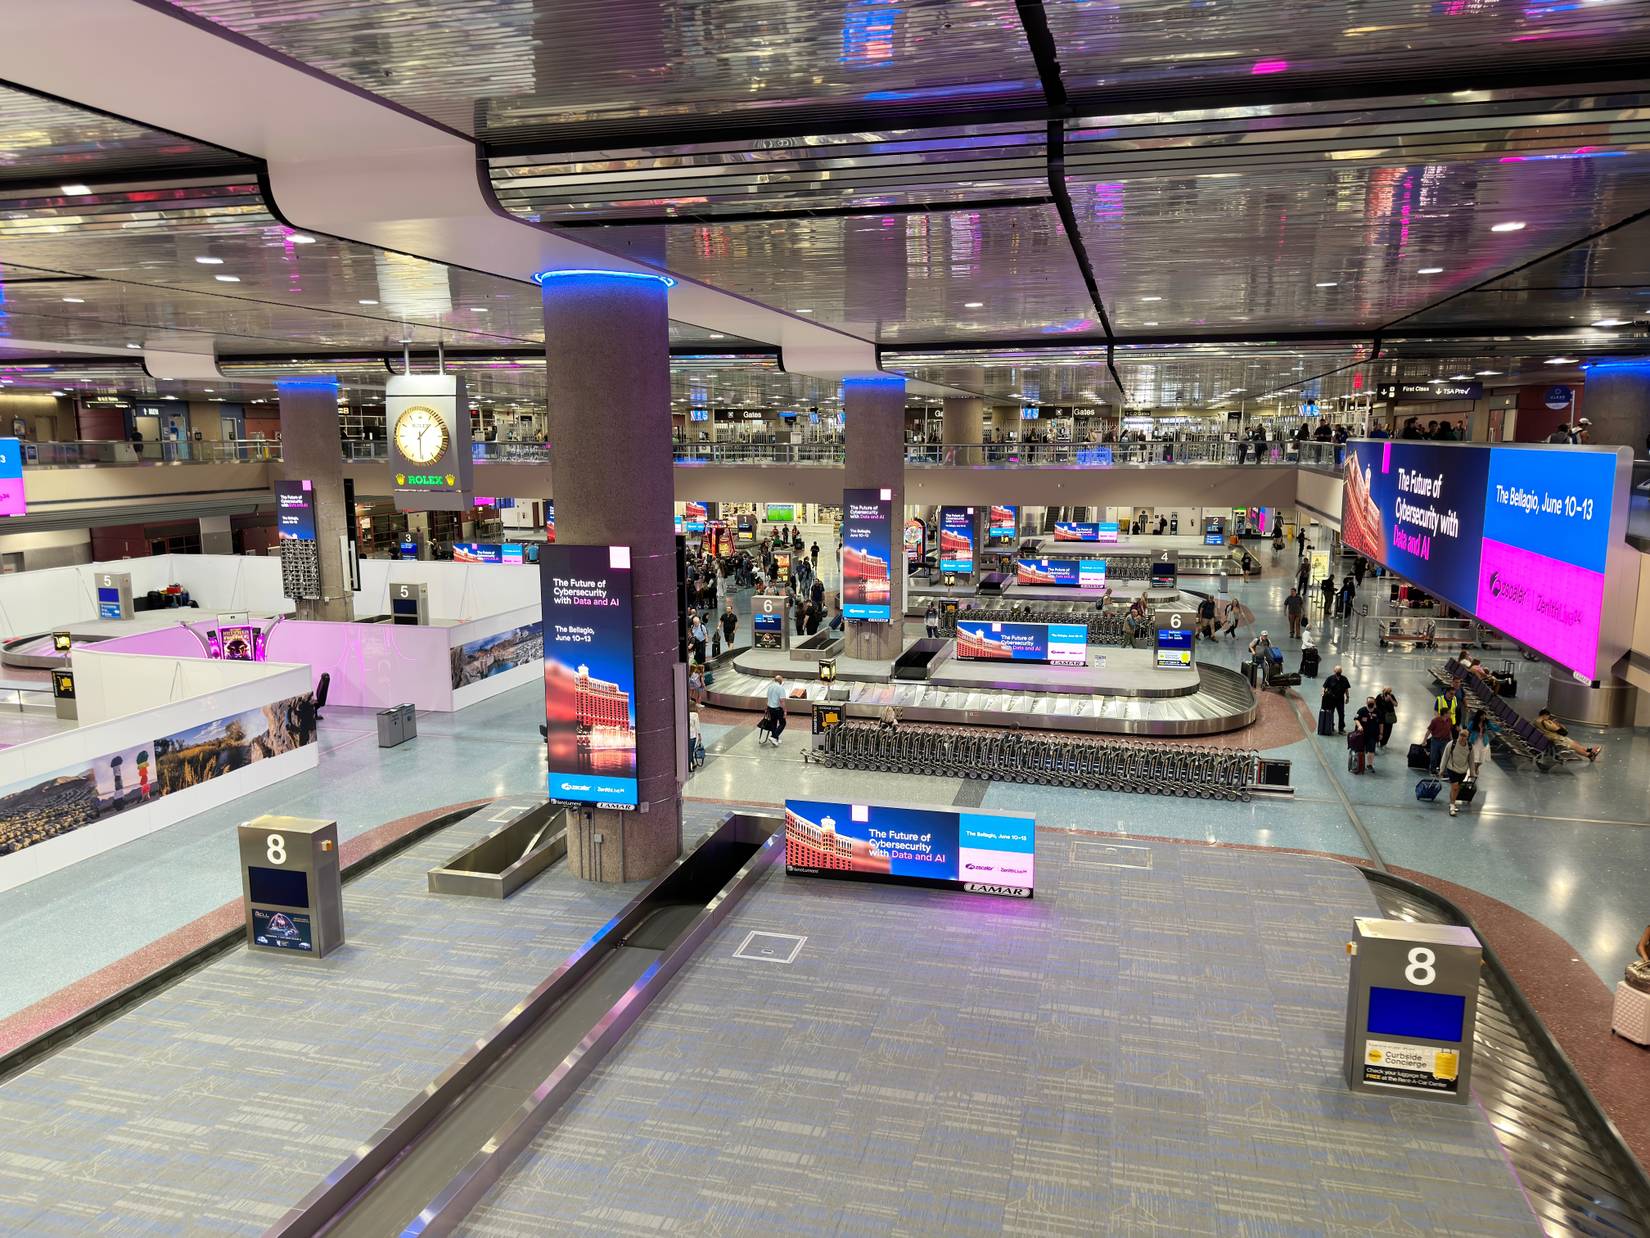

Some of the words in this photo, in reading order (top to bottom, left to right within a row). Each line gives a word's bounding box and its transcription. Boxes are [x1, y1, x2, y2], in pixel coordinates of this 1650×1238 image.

[408, 475, 443, 485] ROLEX
[1398, 468, 1410, 492] The
[1410, 470, 1432, 496] Future
[1432, 474, 1442, 498] of
[1496, 485, 1509, 504] The
[1510, 487, 1540, 514] Bellagio,
[1542, 492, 1562, 515] June
[1396, 496, 1440, 537] Cybersecurity
[1440, 509, 1458, 538] with
[406, 534, 411, 542] 3
[1393, 524, 1407, 550] Data
[1407, 534, 1420, 556] and
[1421, 536, 1430, 560] AI
[1161, 552, 1168, 562] 4
[104, 575, 111, 587] 5
[553, 578, 568, 587] The
[570, 579, 595, 588] Future
[400, 586, 408, 598] 5
[554, 588, 607, 598] Cybersecurity
[554, 596, 571, 604] with
[763, 600, 773, 613] 6
[1170, 614, 1182, 628] 6
[869, 829, 886, 838] The
[889, 831, 919, 841] Future
[921, 833, 931, 842] of
[267, 834, 286, 864] 8
[869, 839, 931, 853] Cybersecurity
[868, 848, 889, 857] with
[892, 850, 913, 860] Data
[915, 852, 932, 861] and
[934, 853, 945, 863] AI
[970, 884, 1023, 895] LAMAR
[1405, 947, 1436, 986] 8
[1386, 1051, 1422, 1060] Curbside
[1385, 1058, 1427, 1068] Concierge
